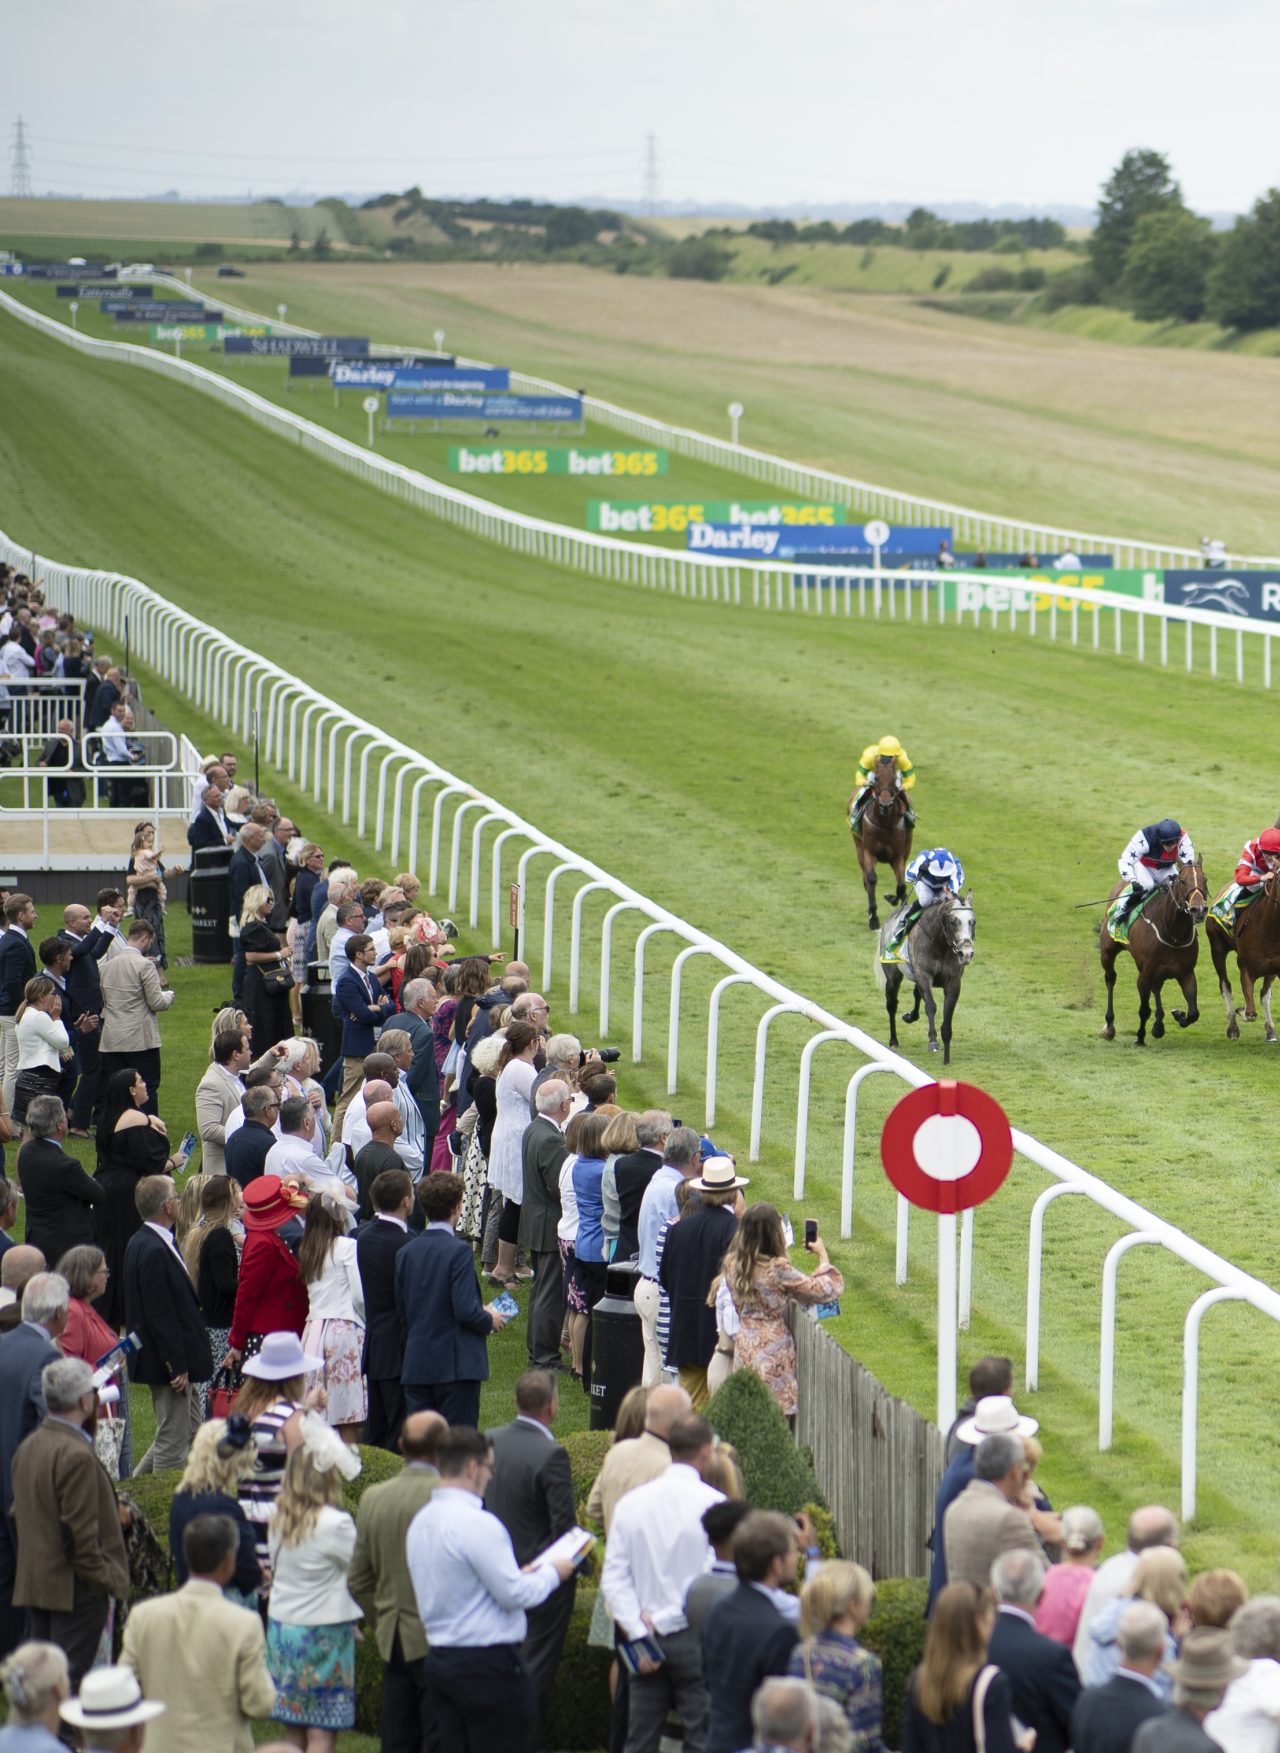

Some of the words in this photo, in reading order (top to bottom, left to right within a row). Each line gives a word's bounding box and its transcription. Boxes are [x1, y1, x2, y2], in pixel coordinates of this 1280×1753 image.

[335, 365, 396, 386] Darley
[458, 449, 548, 474] bet365
[568, 450, 658, 475] bet365
[600, 502, 705, 532] bet365
[690, 522, 780, 554] Darley
